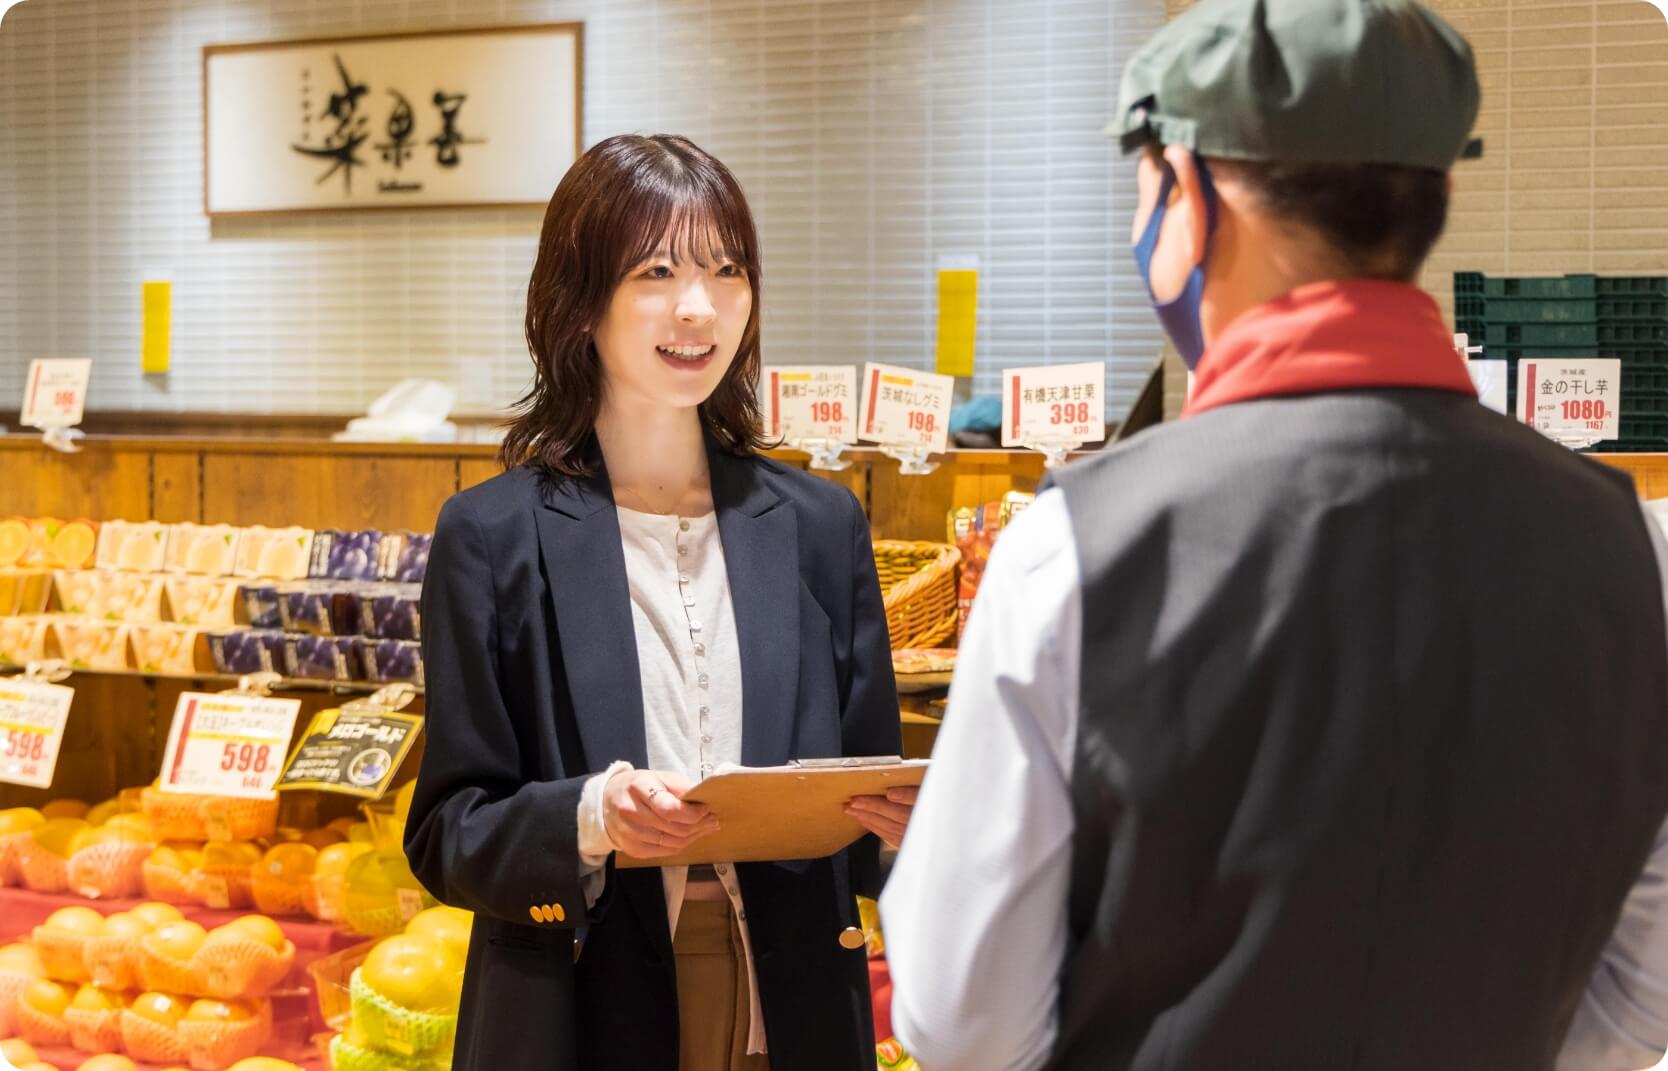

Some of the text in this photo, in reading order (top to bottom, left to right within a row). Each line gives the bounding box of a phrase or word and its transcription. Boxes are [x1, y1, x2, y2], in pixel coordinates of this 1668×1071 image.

[1024, 384, 1095, 403] 有機天津甘栗
[1541, 379, 1608, 395] 金の干し芋
